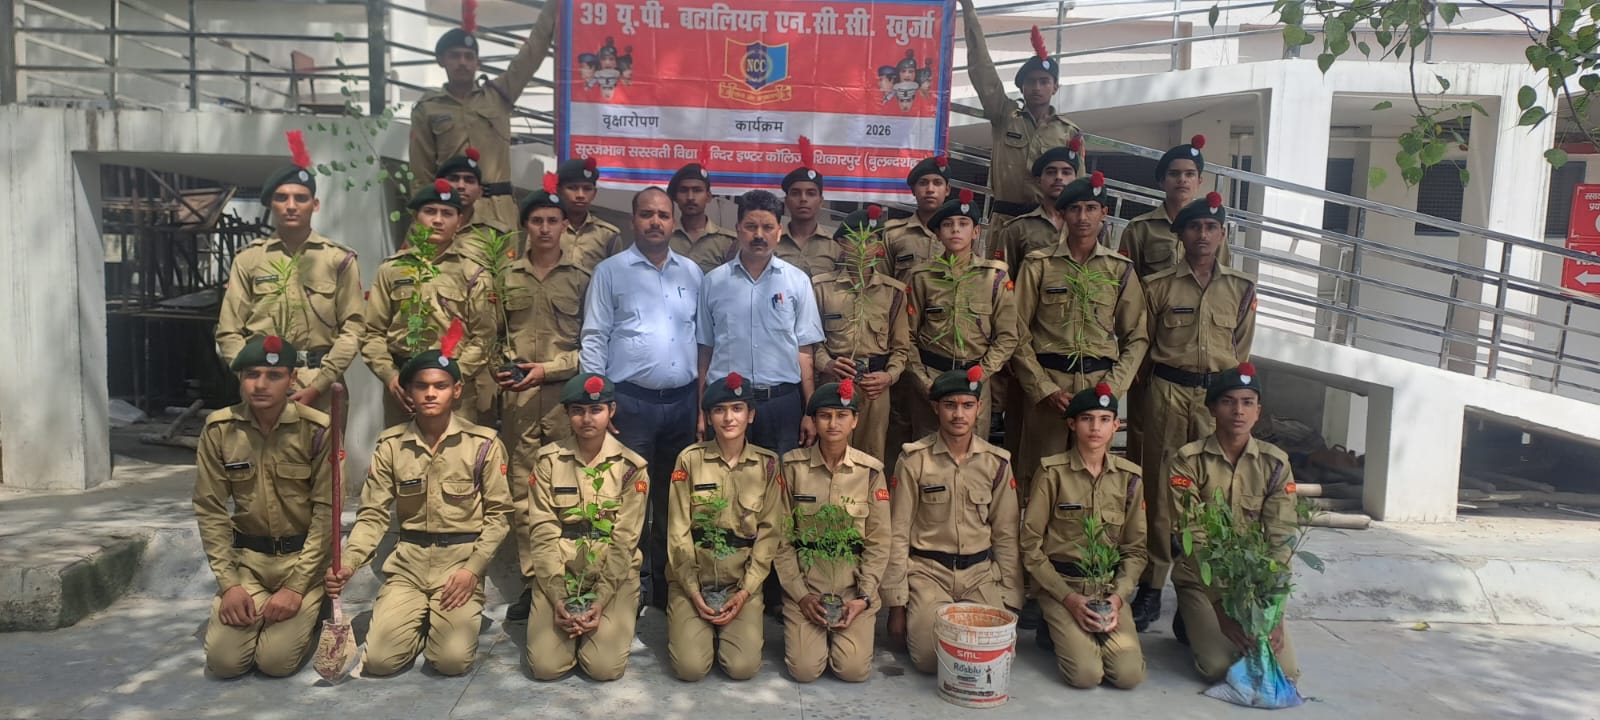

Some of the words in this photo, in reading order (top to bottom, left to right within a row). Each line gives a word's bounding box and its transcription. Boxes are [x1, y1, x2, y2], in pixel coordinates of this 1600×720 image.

[580, 2, 607, 25] 39
[678, 3, 768, 32] बटालियन
[885, 10, 935, 45] खुर्जा
[747, 59, 766, 72] NCC
[602, 111, 659, 129] वृक्षारोपण
[735, 116, 784, 132] कार्यक्रम
[866, 124, 891, 136] 2026
[673, 144, 697, 160] विद्या
[709, 147, 733, 161] न्दिर
[813, 150, 860, 170] शिकारपुर
